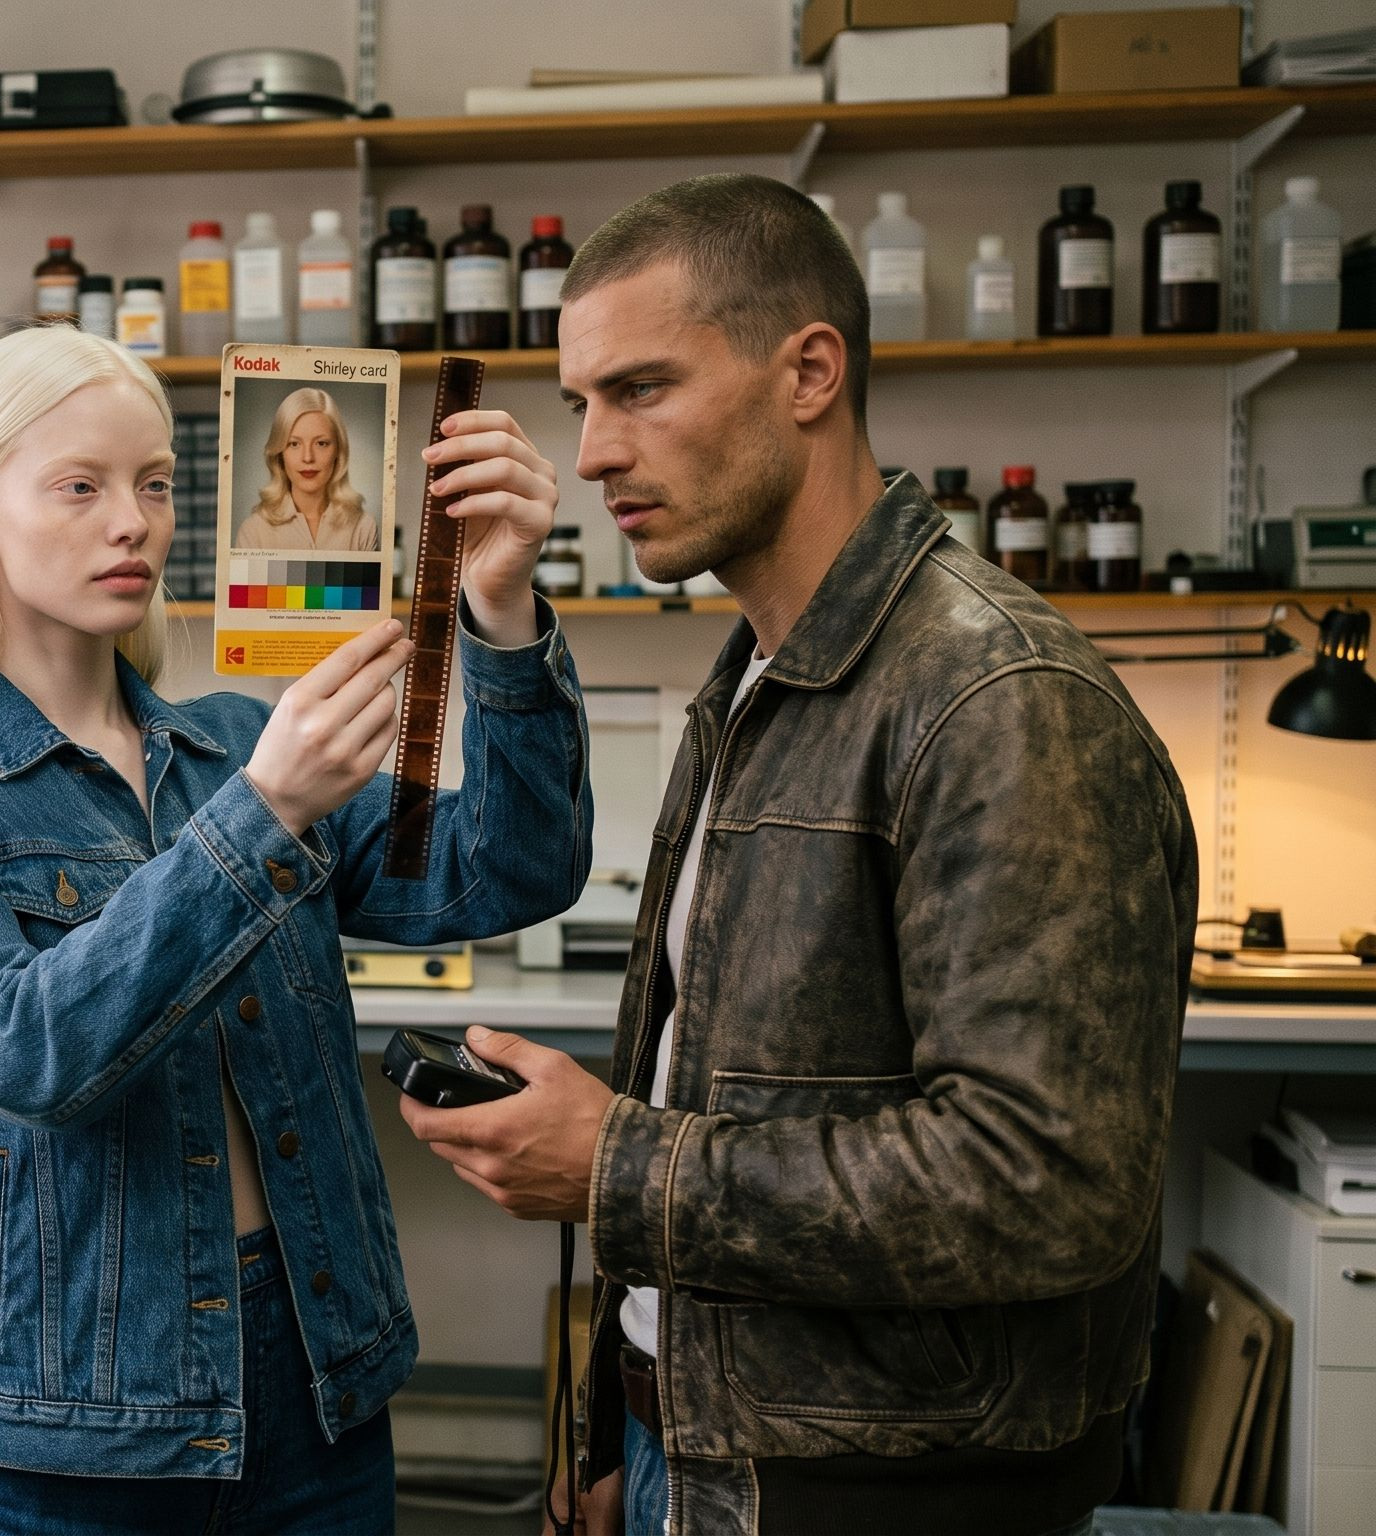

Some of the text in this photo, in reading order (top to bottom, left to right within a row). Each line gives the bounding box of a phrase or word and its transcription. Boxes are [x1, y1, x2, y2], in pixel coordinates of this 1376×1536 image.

[234, 356, 280, 372] Kodak
[313, 360, 387, 379] Shirley card
